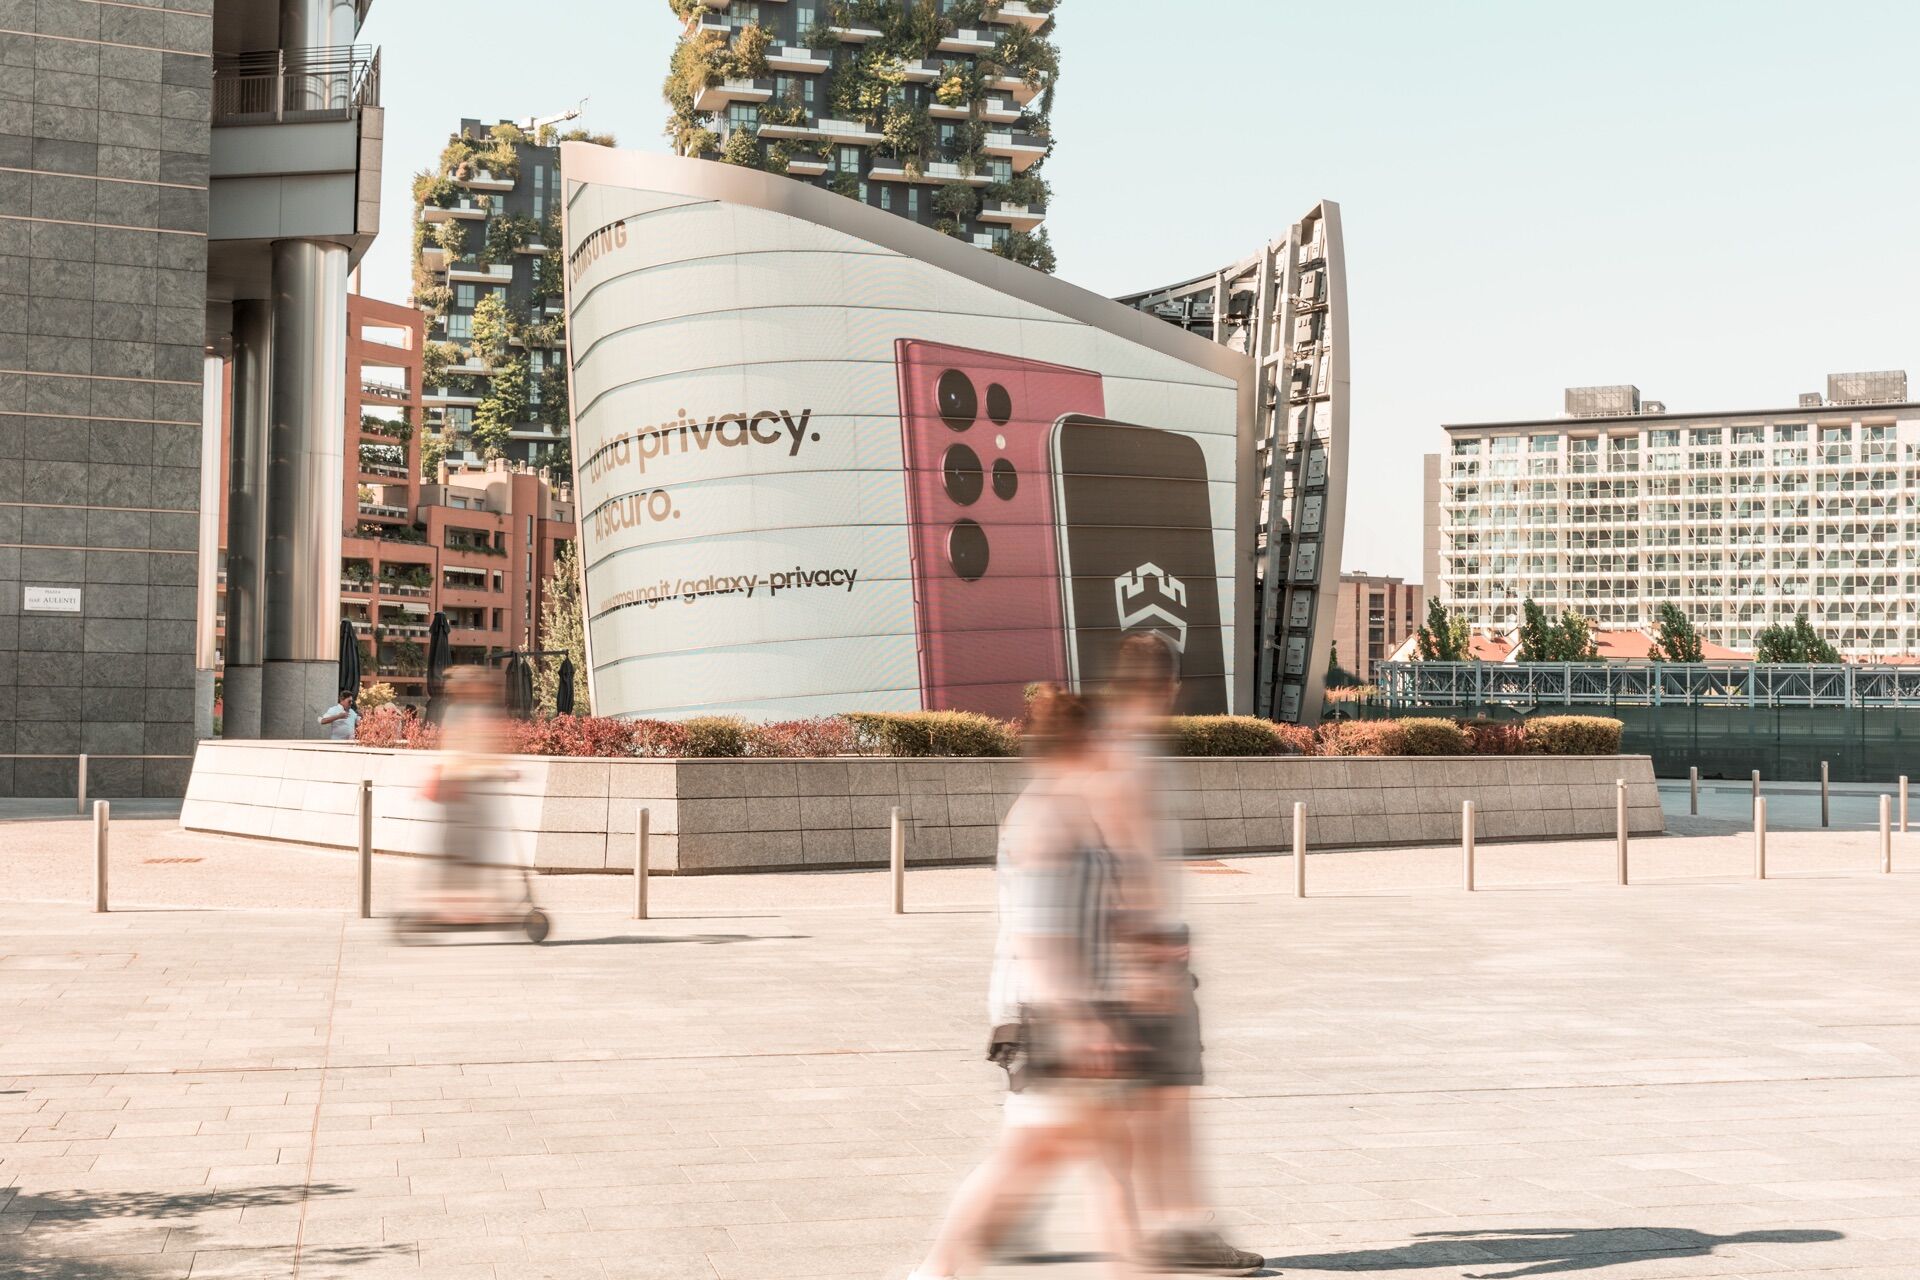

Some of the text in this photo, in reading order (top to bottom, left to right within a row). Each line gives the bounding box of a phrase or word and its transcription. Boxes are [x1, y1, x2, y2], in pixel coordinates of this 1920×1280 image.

[571, 220, 628, 284] SAMSUNG
[600, 431, 631, 473] tua
[636, 407, 821, 474] privacy.
[603, 489, 681, 538] sicuro.
